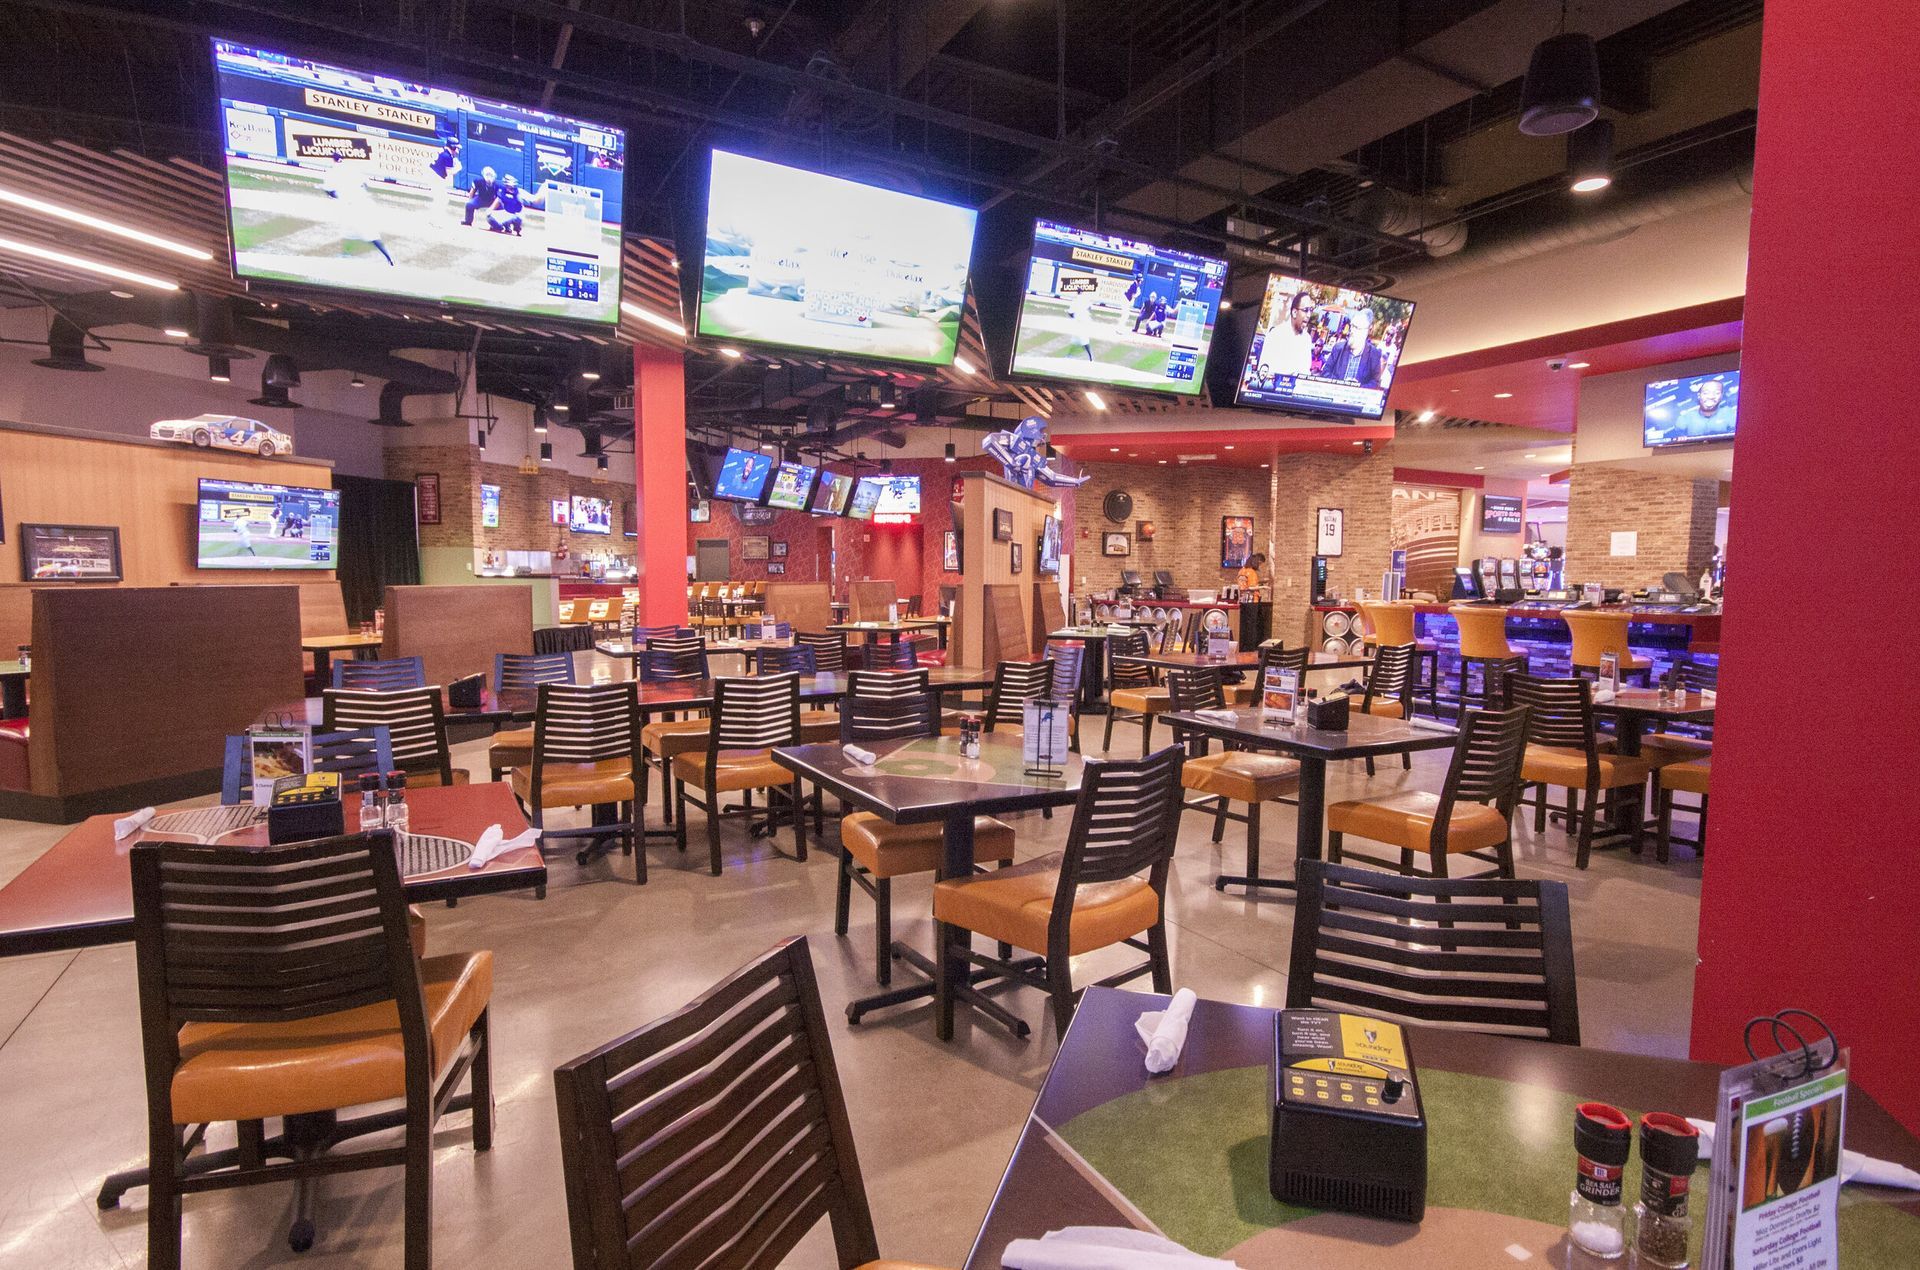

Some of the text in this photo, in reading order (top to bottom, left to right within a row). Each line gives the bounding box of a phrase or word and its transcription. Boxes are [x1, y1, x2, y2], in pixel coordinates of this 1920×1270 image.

[312, 94, 431, 125] STANLEY STANLEY
[312, 137, 353, 149] LUMBER
[302, 145, 366, 158] LIQUIDATORS
[1076, 250, 1132, 267] STANLEY STANLEY
[230, 430, 245, 445] 4
[261, 431, 286, 442] BUSCH
[1325, 523, 1335, 536] 19
[1774, 1091, 1799, 1108] Football
[1580, 1183, 1620, 1197] GRINDER
[1585, 1178, 1616, 1189] SEA SALT
[1758, 1209, 1777, 1221] Friday
[1777, 1200, 1798, 1213] College
[1798, 1189, 1821, 1202] Football
[1769, 1216, 1793, 1231] Domestic
[1752, 1240, 1778, 1257] Saturday
[1778, 1231, 1799, 1245] College
[1799, 1220, 1822, 1235] Football
[1768, 1255, 1780, 1266] Lite
[1780, 1250, 1792, 1260] and
[1792, 1243, 1807, 1255] Coors
[1807, 1236, 1822, 1249] Light
